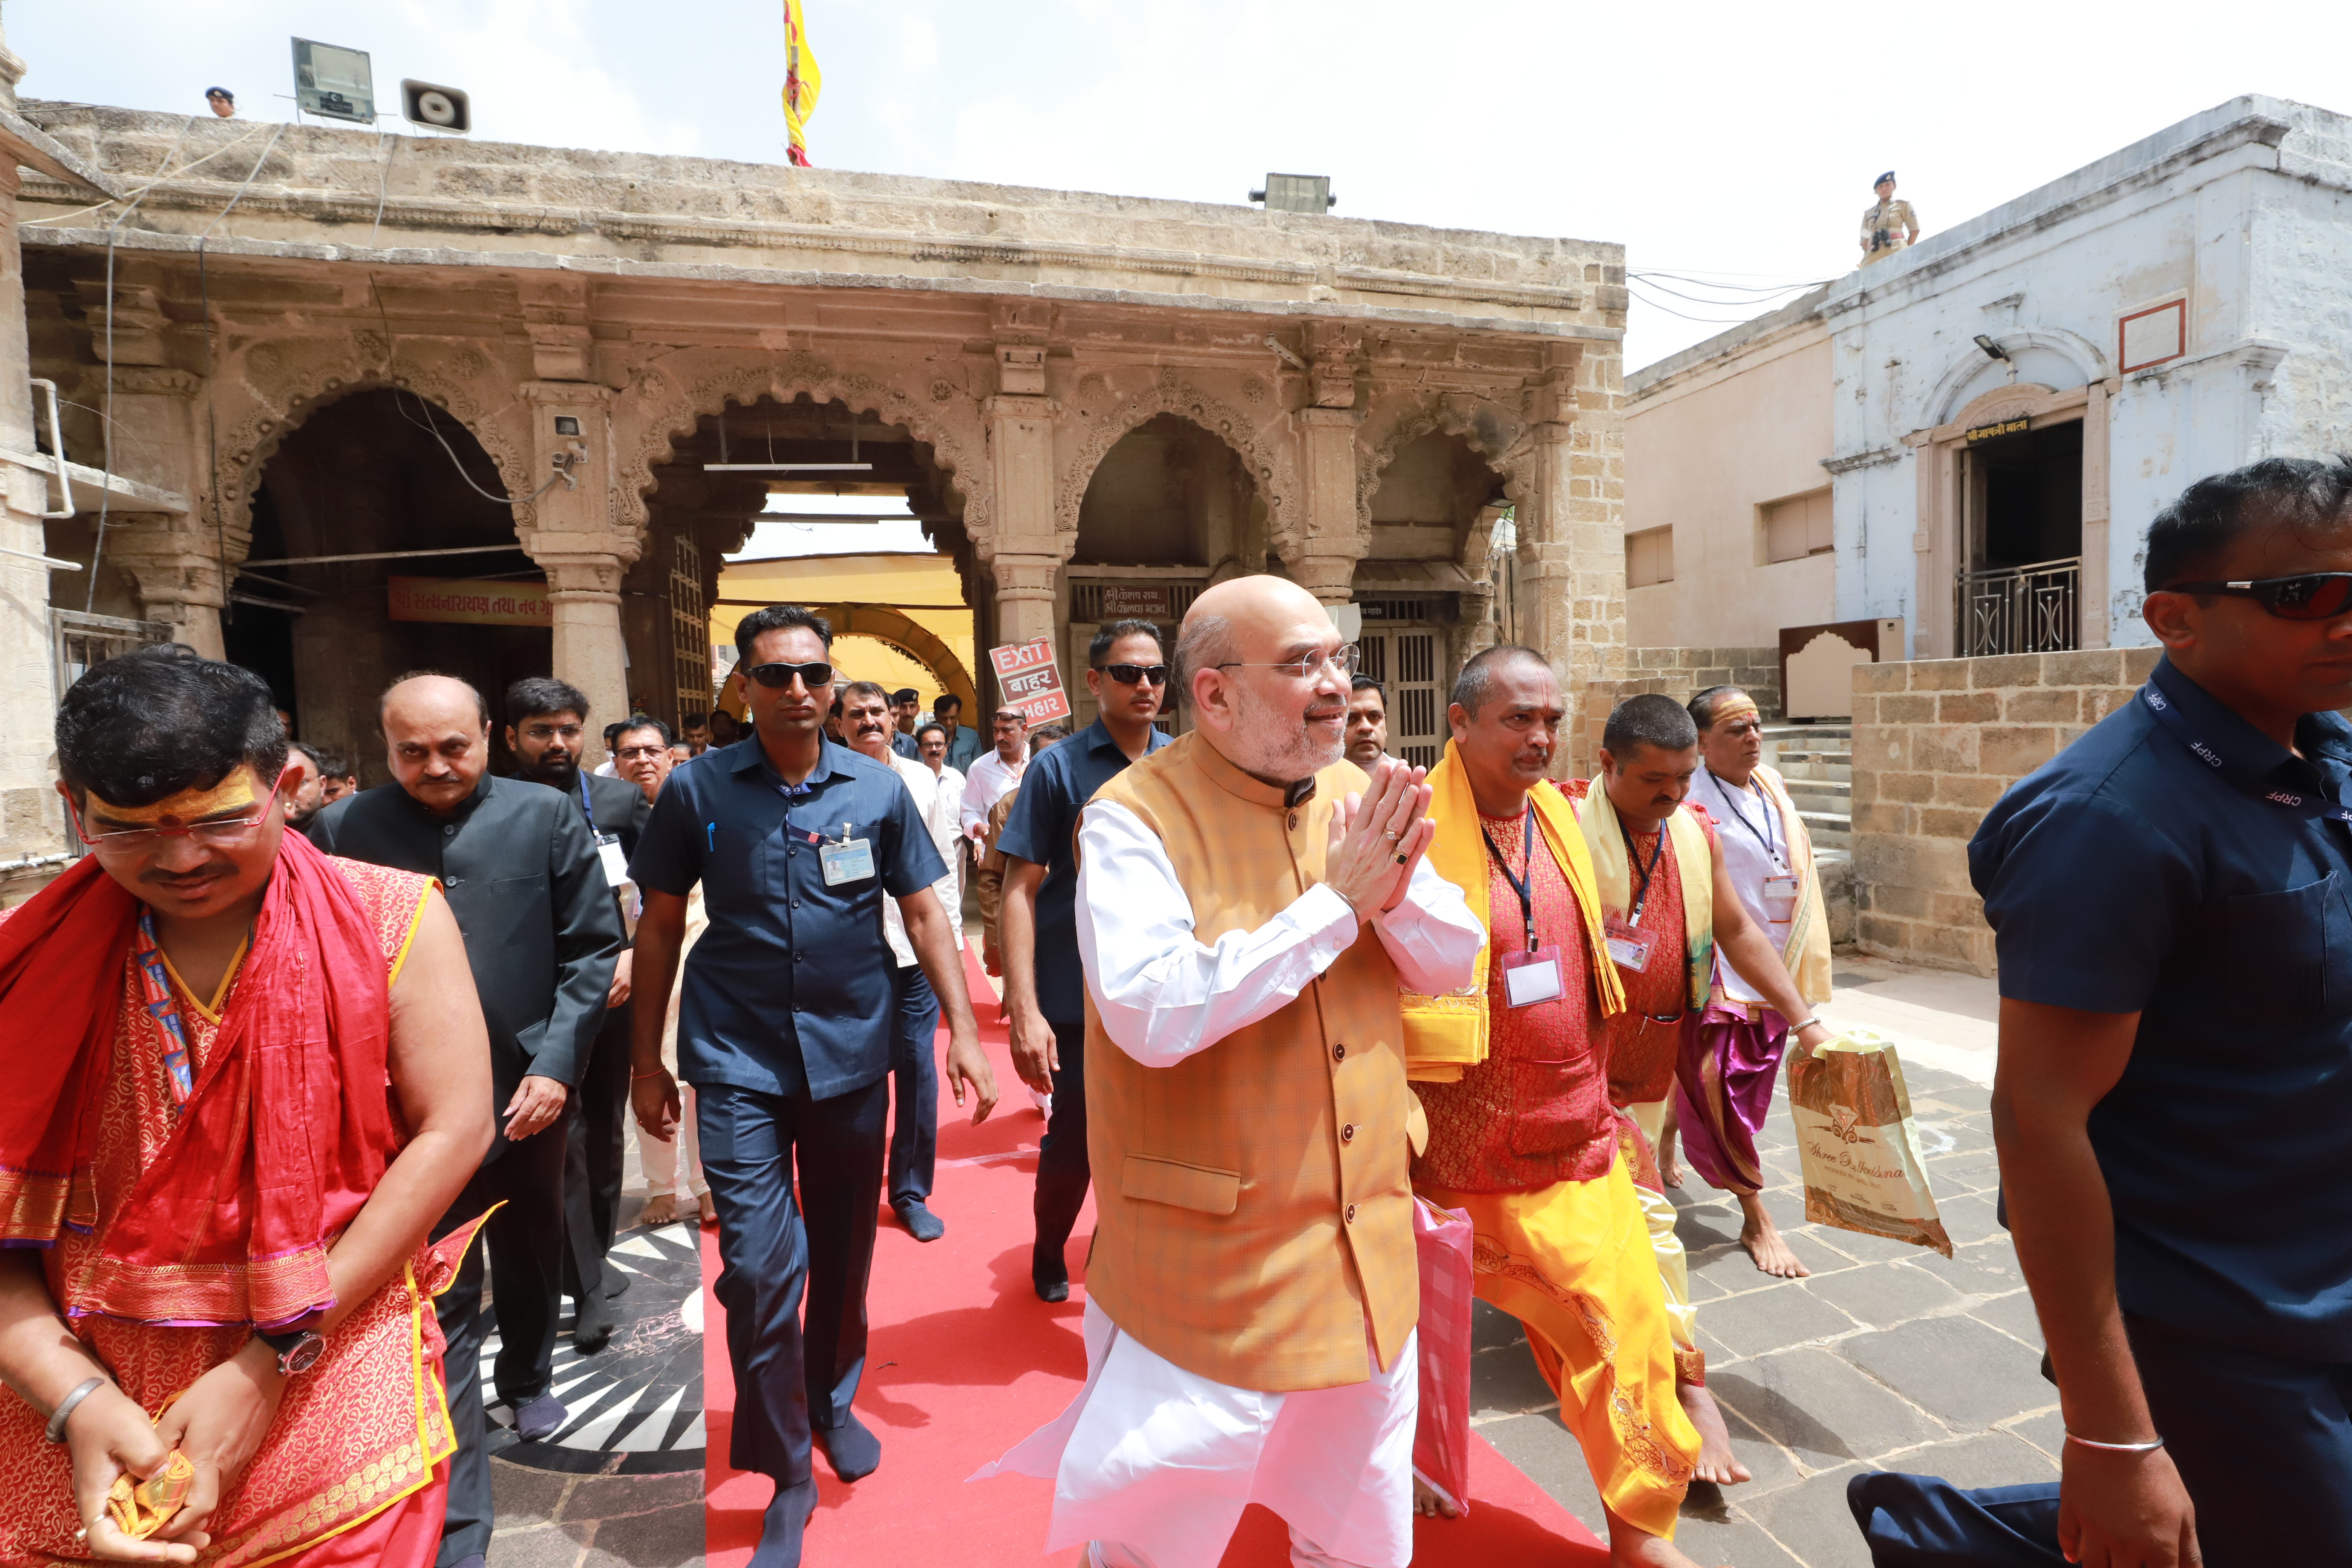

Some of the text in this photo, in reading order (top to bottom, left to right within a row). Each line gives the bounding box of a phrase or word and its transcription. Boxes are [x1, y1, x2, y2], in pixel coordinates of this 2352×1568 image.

[1967, 420, 2027, 441] श्री गायत्री माता
[395, 587, 410, 609] શ્રી
[414, 593, 489, 615] સત્યનારાયણ
[492, 597, 515, 614] તથા
[519, 599, 536, 615] નવ
[998, 643, 1043, 670] EXIT
[2149, 693, 2167, 710] CRPF
[2191, 742, 2222, 767] CRPF
[2266, 792, 2301, 806] CRPF
[1807, 1142, 1836, 1162] Shree
[1825, 1165, 1846, 1177] PIONEER
